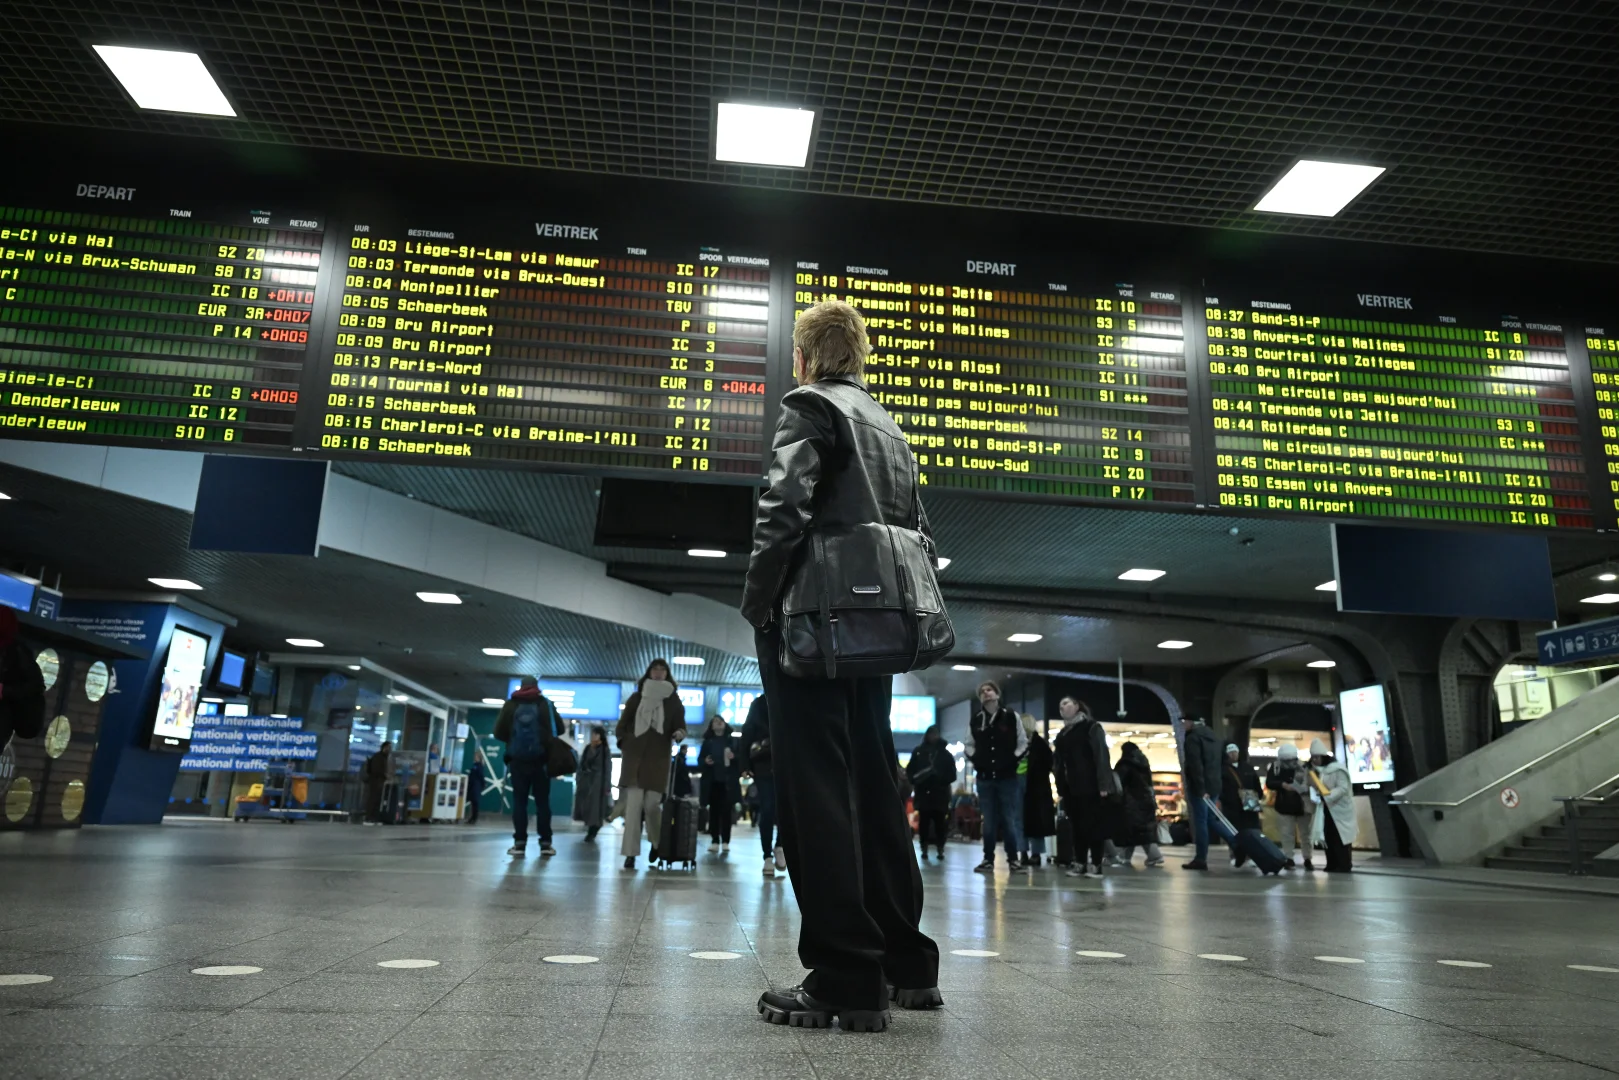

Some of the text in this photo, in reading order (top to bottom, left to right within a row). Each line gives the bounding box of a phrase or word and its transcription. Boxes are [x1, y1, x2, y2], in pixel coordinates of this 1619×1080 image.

[77, 184, 136, 200] DEPART
[170, 209, 191, 217] TRAIN
[290, 220, 317, 228] RETARD
[536, 223, 598, 240] VERTREK
[49, 233, 77, 244] via
[87, 235, 113, 247] Hal
[218, 246, 237, 258] S2
[352, 238, 396, 251] 08:03
[521, 252, 547, 264] via
[556, 254, 599, 268] Namur
[677, 264, 693, 276] IC
[704, 266, 719, 278] 17
[408, 229, 454, 239] BESTEMMING
[728, 256, 769, 266] VERTRAGING
[45, 252, 72, 264] via
[82, 254, 196, 274] Brux-Schuman
[245, 268, 262, 280] 13
[349, 256, 692, 294] 08:03 Termonde via Brux-Ouest S10
[967, 260, 1016, 276] DEPART
[211, 285, 230, 297] IC
[242, 287, 258, 299] 18
[346, 275, 691, 313] 08:04 Montpellier TGV
[796, 273, 1135, 313] 08:18 Termonde via Jette IC 10
[847, 266, 888, 275] DESTINATION
[1151, 292, 1174, 300] RETARD
[198, 303, 226, 316] EUR
[245, 307, 264, 319] 3A
[1252, 301, 1291, 310] BESTEMMING
[1357, 294, 1412, 309] VERTREK
[920, 303, 944, 314] via
[953, 305, 975, 317] Hal
[1097, 317, 1112, 329] S3
[1206, 309, 1521, 343] 08:37 Gand-St-P IC 8
[340, 314, 715, 353] 08:09 Bru Airport IC 3
[1207, 326, 1524, 362] 08:38 Anvers-C via Malines S1 20
[1209, 344, 1415, 370] 08:39 Courtrai via Zottegem
[334, 354, 380, 368] 08:13
[390, 357, 481, 375] Paris-Nord
[660, 376, 686, 389] EUR
[704, 379, 712, 391] 6
[193, 385, 212, 397] IC
[231, 387, 241, 399] 9
[331, 373, 711, 410] 08:14 Tournai via Hal IC 17
[1258, 384, 1274, 395] Ne
[1282, 386, 1335, 400] circule
[1343, 392, 1366, 402] pas
[12, 393, 237, 420] Denderleeuw IC 12
[325, 414, 372, 428] 08:15
[381, 418, 483, 436] Charleroi-C
[493, 426, 520, 438] via
[665, 436, 683, 449] IC
[692, 438, 707, 450] 21
[911, 414, 1142, 441] via Schaerbeek S2 14
[1214, 417, 1515, 449] 08:44 Rotterdam C EC
[953, 436, 1143, 460] via Gand-St-P IC 9
[937, 454, 1144, 480] La Louv-Sud IC 20
[1217, 455, 1256, 468] 08:45
[1265, 458, 1351, 475] Charleroi-C
[1359, 465, 1382, 477] via
[1505, 474, 1520, 486] IC
[1528, 475, 1541, 487] 21
[1218, 474, 1546, 506] 08:50 Essen via Anvers IC 20
[224, 716, 302, 728] internationales
[246, 732, 316, 744] verbindingen
[248, 745, 318, 757] Reiseverkehr
[236, 759, 268, 770] traffic
